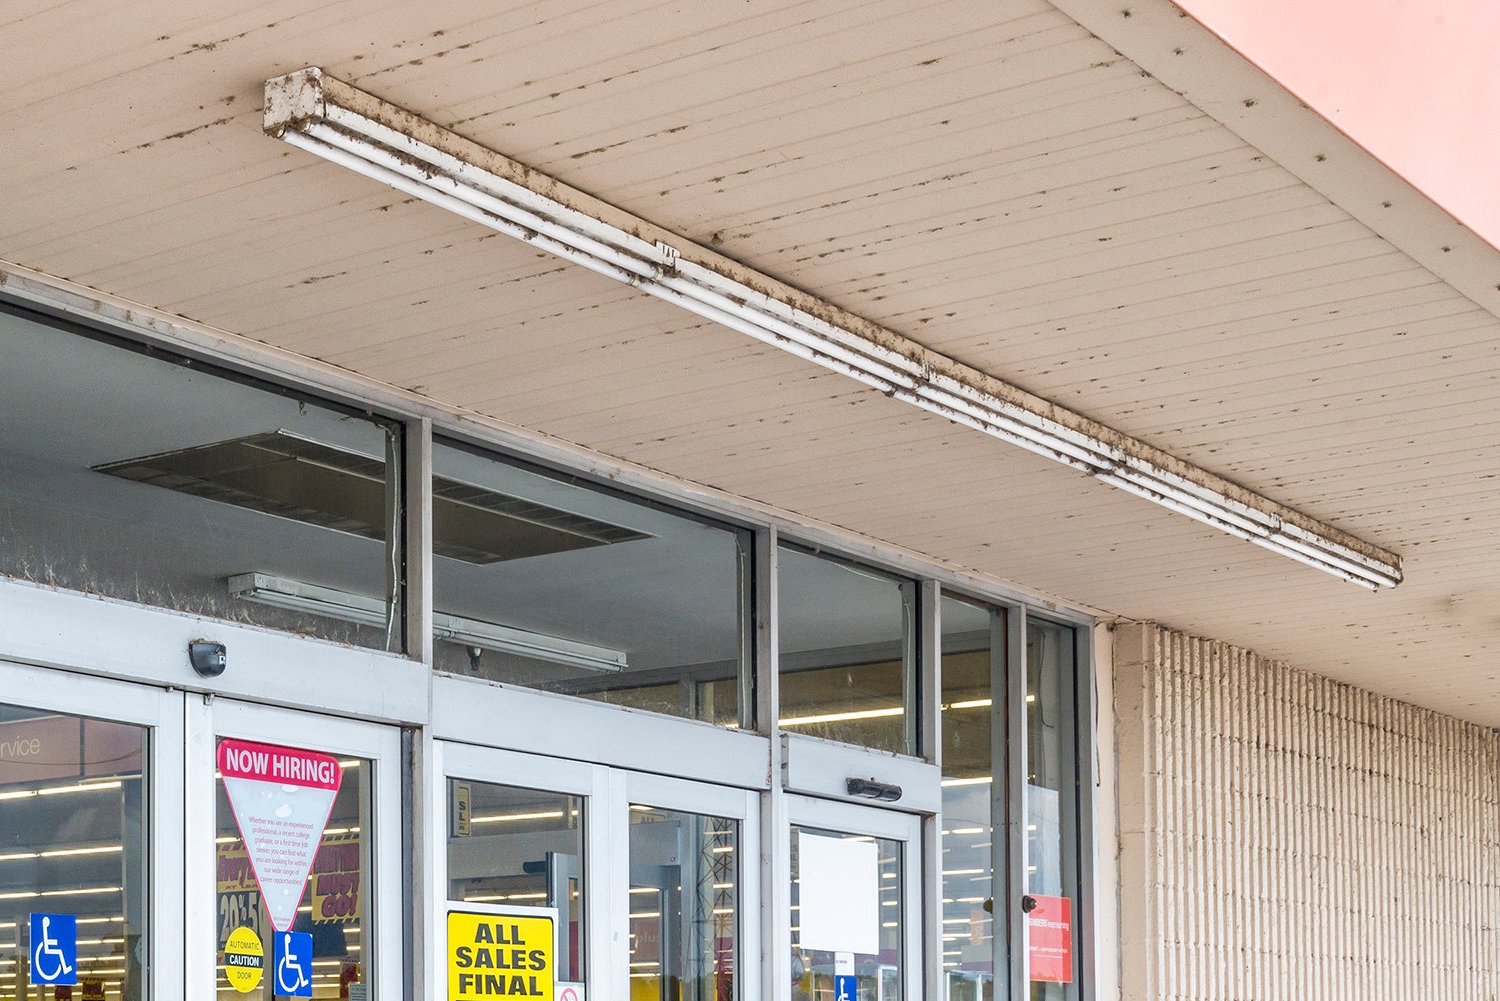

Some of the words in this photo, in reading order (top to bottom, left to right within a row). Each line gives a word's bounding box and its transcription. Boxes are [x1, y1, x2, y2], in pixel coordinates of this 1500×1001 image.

[226, 747, 269, 776] NOW
[273, 754, 335, 785] HIRING!
[230, 940, 260, 950] AUTOMATIC
[475, 923, 526, 945] ALL
[229, 955, 260, 967] CAUTION
[456, 946, 546, 971] SALES
[236, 971, 252, 980] DOOR
[459, 973, 544, 996] FINAL
